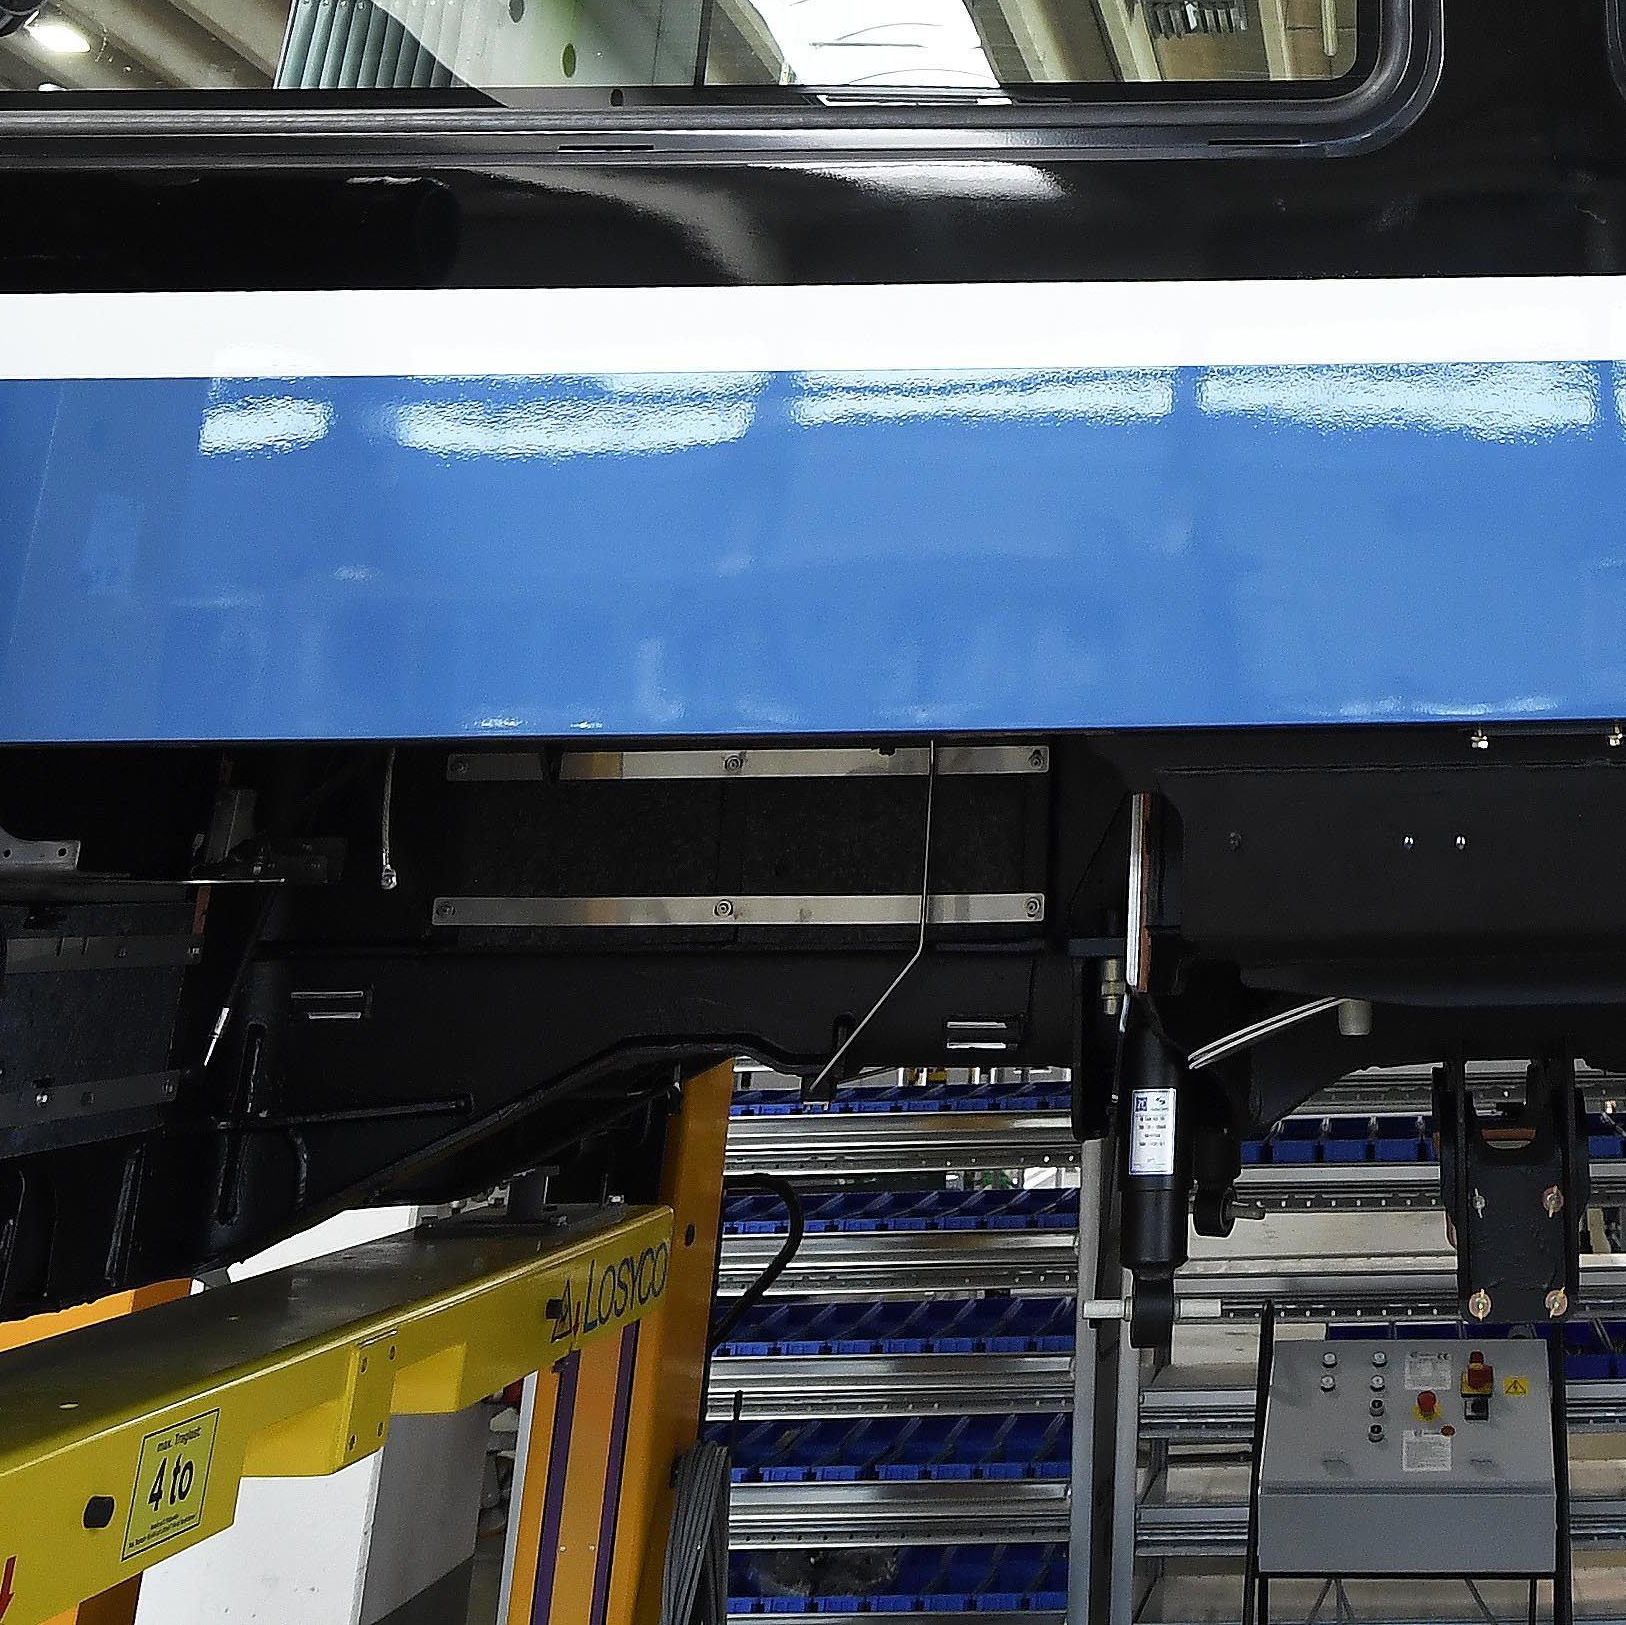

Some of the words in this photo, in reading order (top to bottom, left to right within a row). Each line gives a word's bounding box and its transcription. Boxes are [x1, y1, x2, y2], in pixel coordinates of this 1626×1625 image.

[583, 1241, 668, 1333] LOSYCO
[147, 1457, 168, 1512] 4
[168, 1453, 195, 1505] to
